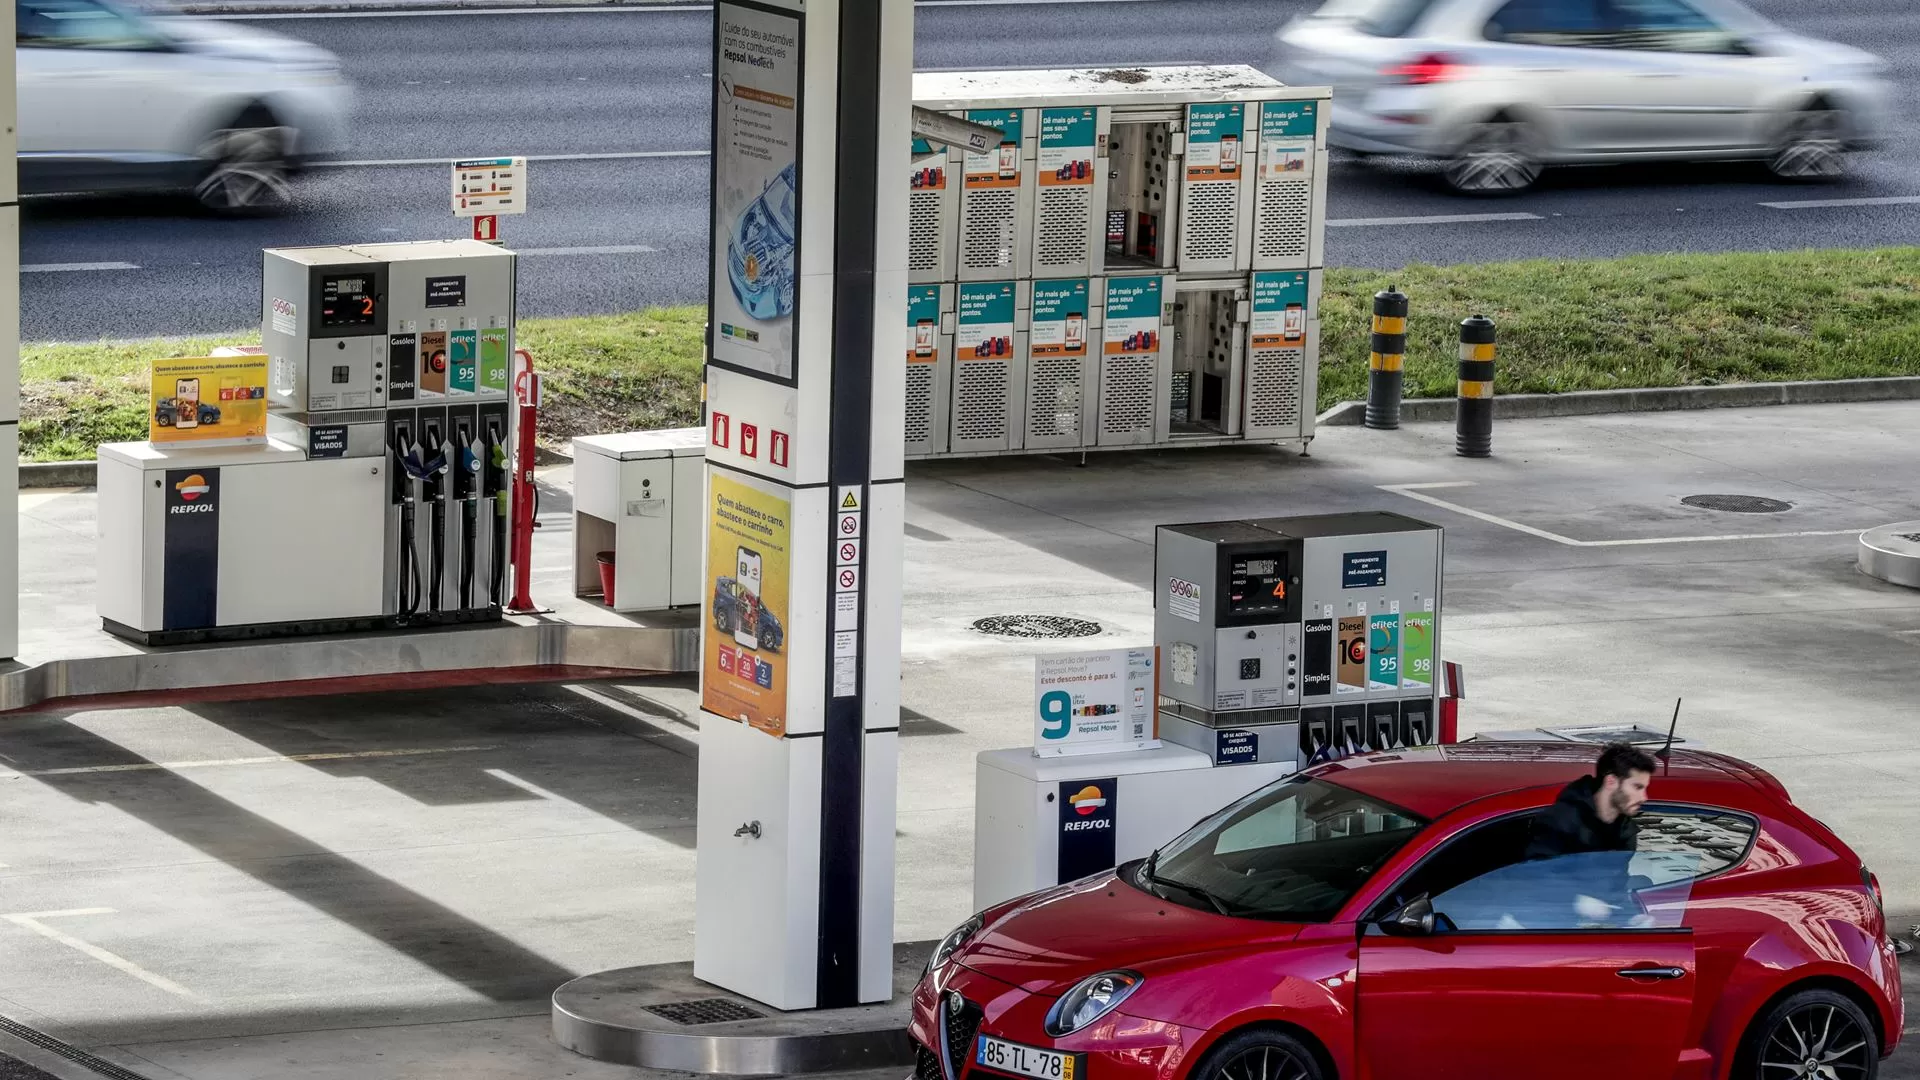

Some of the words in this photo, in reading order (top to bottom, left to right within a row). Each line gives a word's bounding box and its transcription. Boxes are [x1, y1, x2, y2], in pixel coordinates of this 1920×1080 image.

[724, 22, 740, 35] Cuide
[741, 26, 749, 37] do
[751, 30, 761, 39] seu
[762, 32, 794, 48] automóvel
[724, 37, 737, 46] com
[738, 40, 745, 49] os
[746, 42, 786, 59] combustíveis
[724, 49, 746, 63] Repsol
[1215, 112, 1225, 120] gás
[1287, 111, 1298, 119] gás
[1067, 116, 1078, 125] gás
[971, 135, 986, 148] ADT
[1279, 281, 1290, 289] gás
[1059, 290, 1070, 299] gás
[1132, 287, 1143, 296] gás
[985, 294, 997, 302] gás
[362, 298, 373, 315] 2
[390, 337, 415, 346] Gasóleo
[421, 335, 445, 345] Diesel
[451, 334, 476, 344] efitec
[155, 365, 171, 373] Quem
[458, 367, 475, 380] 95
[490, 368, 505, 381] 98
[390, 381, 414, 390] Simples
[314, 442, 343, 450] VISADOS
[170, 503, 214, 514] REPSOL
[717, 493, 735, 508] Quem
[735, 501, 760, 519] abastece
[767, 515, 785, 529] carro,
[716, 507, 742, 523] abastece
[747, 521, 773, 536] carrinho
[1273, 580, 1285, 599] 4
[1339, 621, 1364, 632] Diesel
[1371, 620, 1398, 630] efitec
[1405, 618, 1431, 627] efitec
[1305, 623, 1331, 633] Gasóleo
[720, 653, 727, 667] 6
[1056, 656, 1076, 665] cartão
[1085, 655, 1111, 664] parceiro
[1380, 657, 1396, 671] 95
[1413, 658, 1430, 672] 98
[1046, 667, 1067, 675] Repsol
[1041, 677, 1056, 685] Este
[1057, 675, 1087, 684] desconto
[1088, 673, 1093, 682] é
[1094, 674, 1108, 682] para
[1304, 673, 1330, 683] Simples
[1040, 690, 1071, 740] 9
[1078, 725, 1100, 734] Repsol
[1222, 745, 1253, 755] VISADOS
[1064, 819, 1111, 831] REPSOL
[1064, 1056, 1073, 1066] 17
